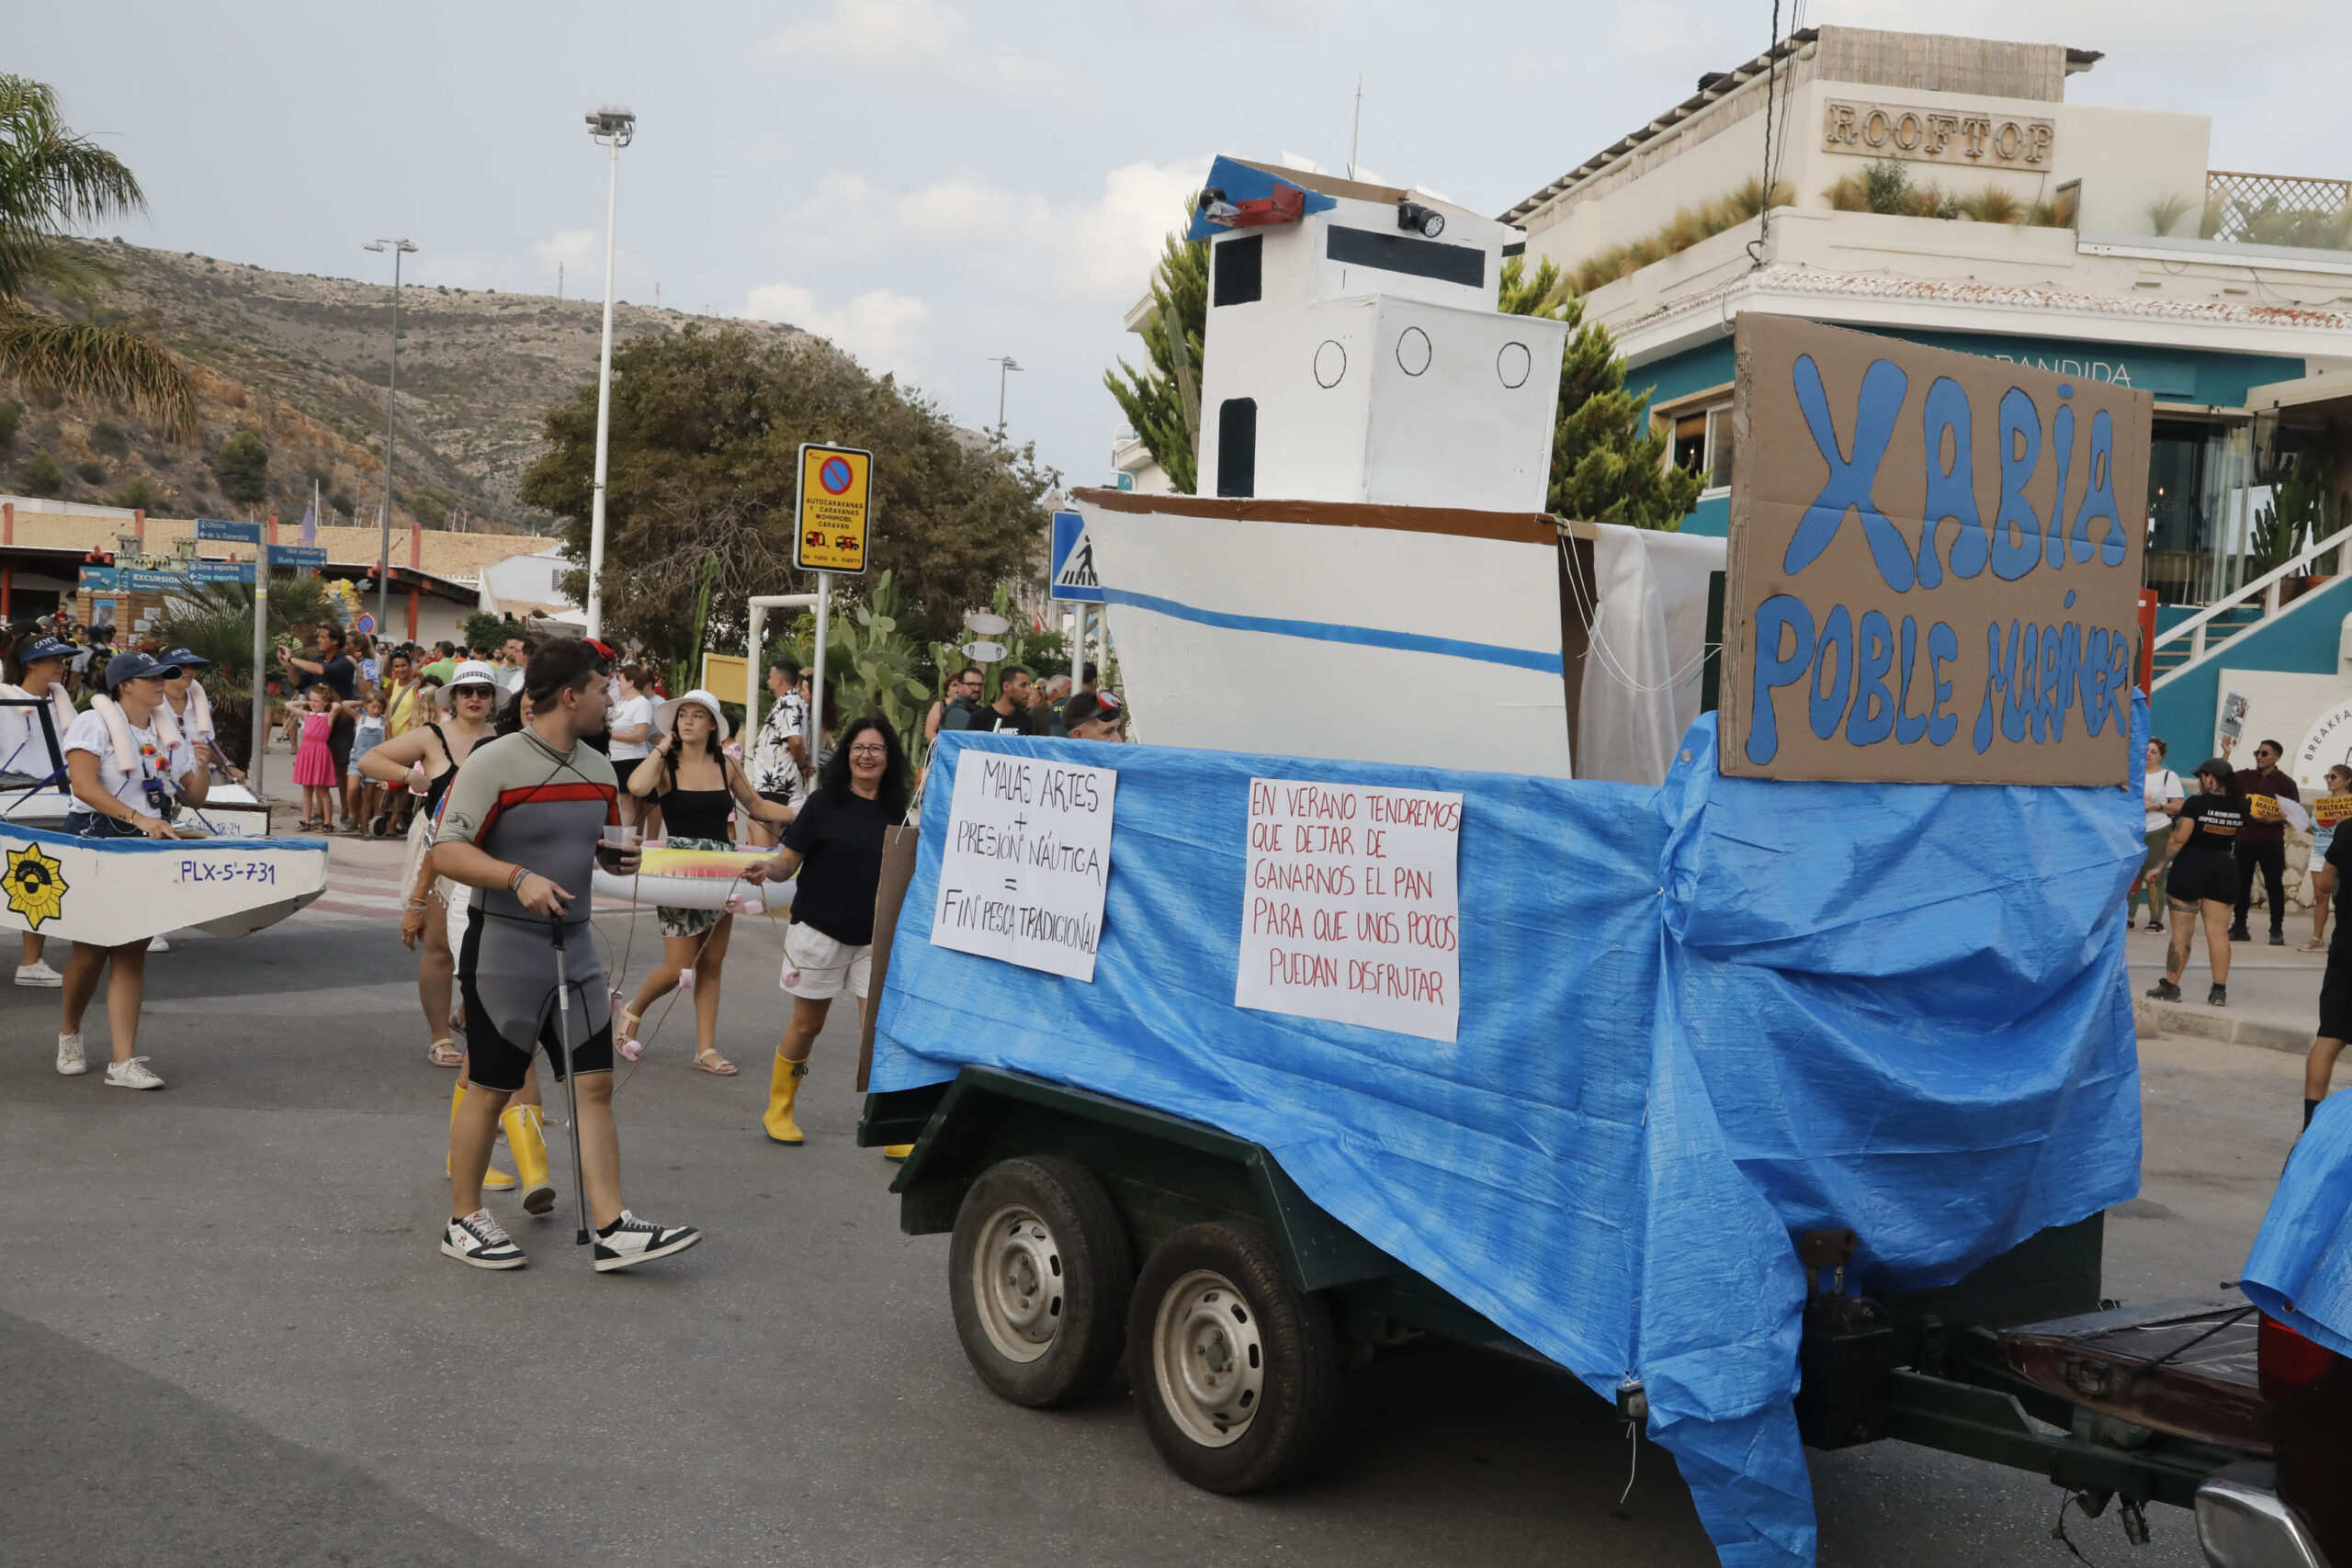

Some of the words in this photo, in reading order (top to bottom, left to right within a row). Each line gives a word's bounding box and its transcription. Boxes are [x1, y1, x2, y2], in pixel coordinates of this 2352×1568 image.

[1826, 104, 2054, 163] ROOFTOP
[1995, 355, 2132, 388] NDIDA
[806, 498, 863, 509] AUTOCARAVANAS
[815, 514, 853, 523] WOHNMOBIL
[820, 506, 859, 516] CARAVANAS
[818, 521, 849, 530] CARAVAN
[133, 573, 190, 584] EXCURSION
[214, 565, 240, 573] esportiva
[214, 574, 240, 582] deportiva
[1746, 593, 1958, 765] POBLE
[982, 759, 1031, 804] MALAS
[1040, 768, 1098, 812] ARTES
[1252, 783, 1276, 816] EN
[1286, 786, 1357, 820] VERANO
[1366, 795, 1461, 832] TENDREMOS
[2256, 801, 2279, 812] MALTR
[957, 819, 1024, 863] PRESIÓN
[1029, 830, 1101, 886] NÁUTICA
[1252, 822, 1283, 852] QUE
[1295, 825, 1354, 855] DEJAR
[1366, 829, 1386, 858] DE
[1254, 858, 1355, 896] GANARNOS
[1366, 866, 1385, 896] EL
[1395, 866, 1432, 900] PAN
[943, 889, 981, 931] FIN
[982, 901, 1014, 942] PESCA
[1020, 907, 1096, 955] TRADICIONAL
[1253, 897, 1304, 939] PARA
[1314, 908, 1348, 942] QUE
[1357, 911, 1399, 944] UNOS
[1408, 911, 1456, 952] POCOS
[1270, 947, 1338, 987] PUEDAN
[1347, 959, 1443, 1006] DISFRUTAR
